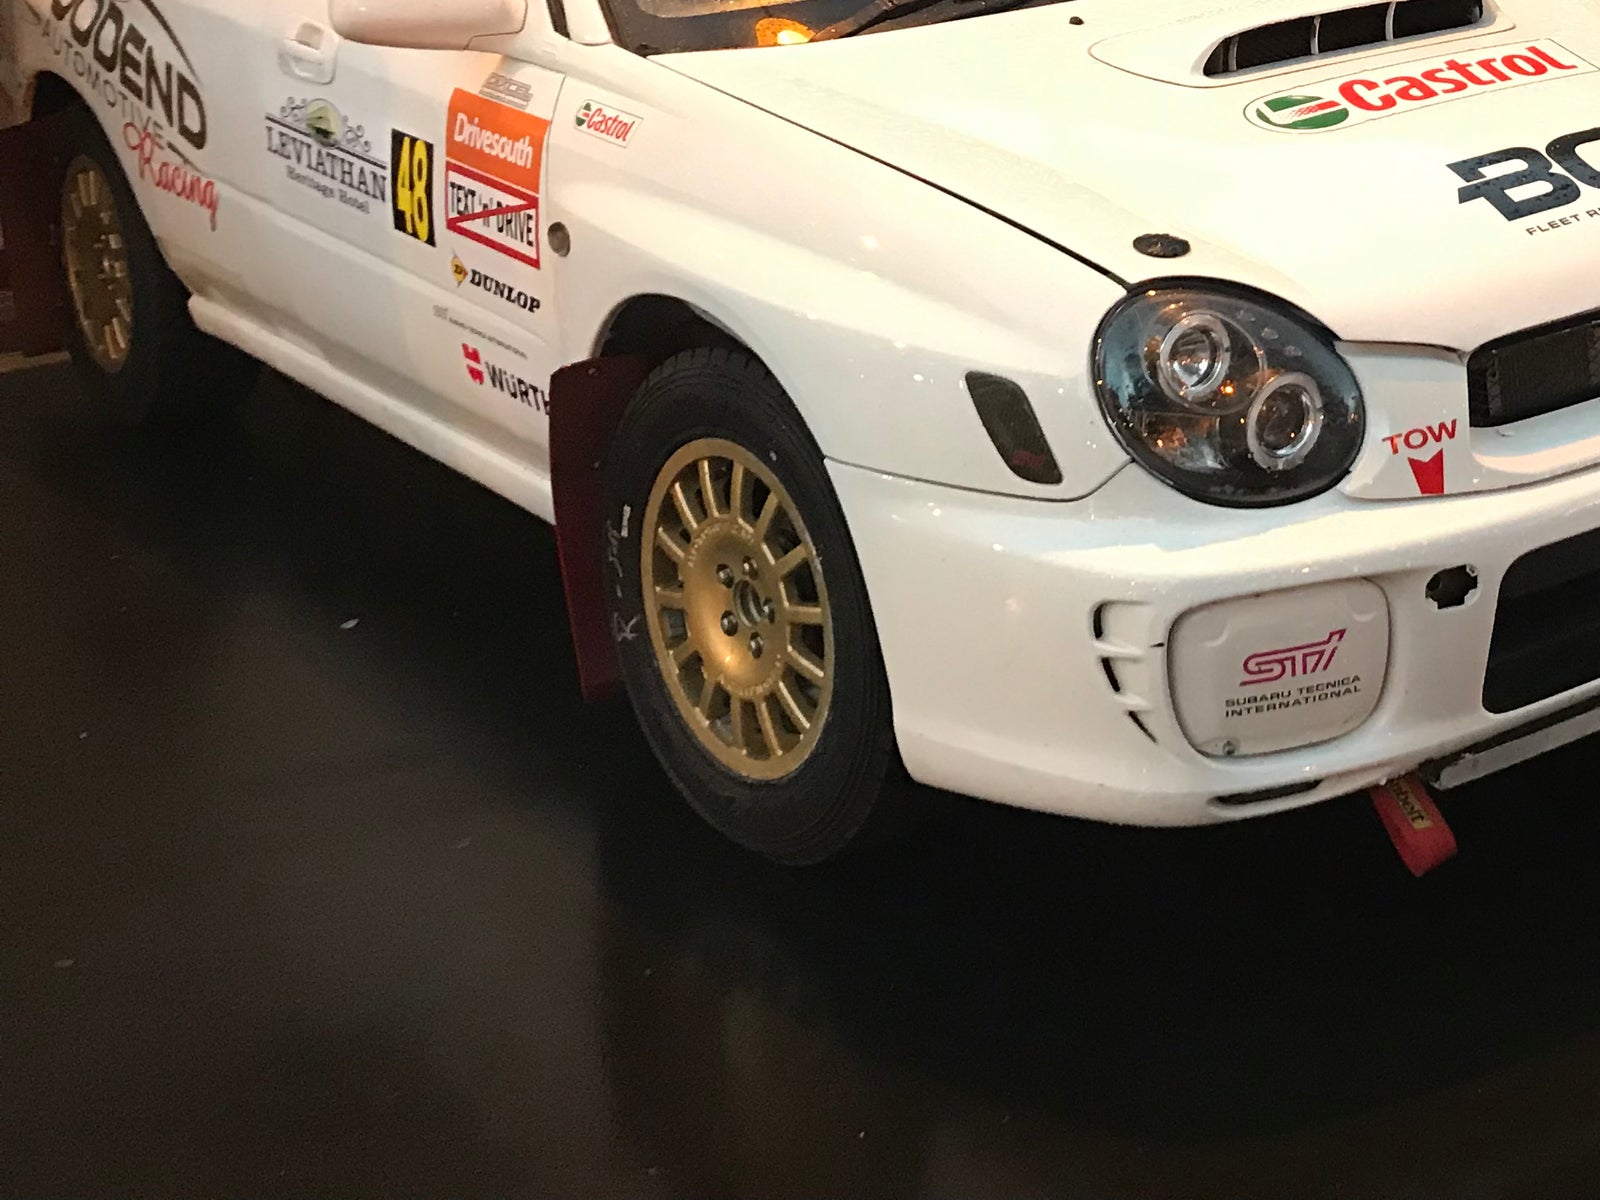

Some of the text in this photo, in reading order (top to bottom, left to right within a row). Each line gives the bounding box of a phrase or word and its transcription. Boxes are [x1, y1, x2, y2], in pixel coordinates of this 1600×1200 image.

[1337, 44, 1579, 112] Castrol
[453, 112, 534, 170] Drivesouth
[586, 107, 636, 143] Castrol
[265, 125, 388, 202] LEVIATHAN
[396, 135, 429, 242] 48
[449, 180, 476, 216] TEXT
[496, 200, 535, 247] DRIVE
[1525, 213, 1582, 236] FLEET
[468, 267, 541, 314] DUNLOP
[1381, 419, 1458, 456] TOW
[1225, 674, 1361, 708] SUBARU TECNICA
[1225, 684, 1362, 719] INTERNATIONAL
